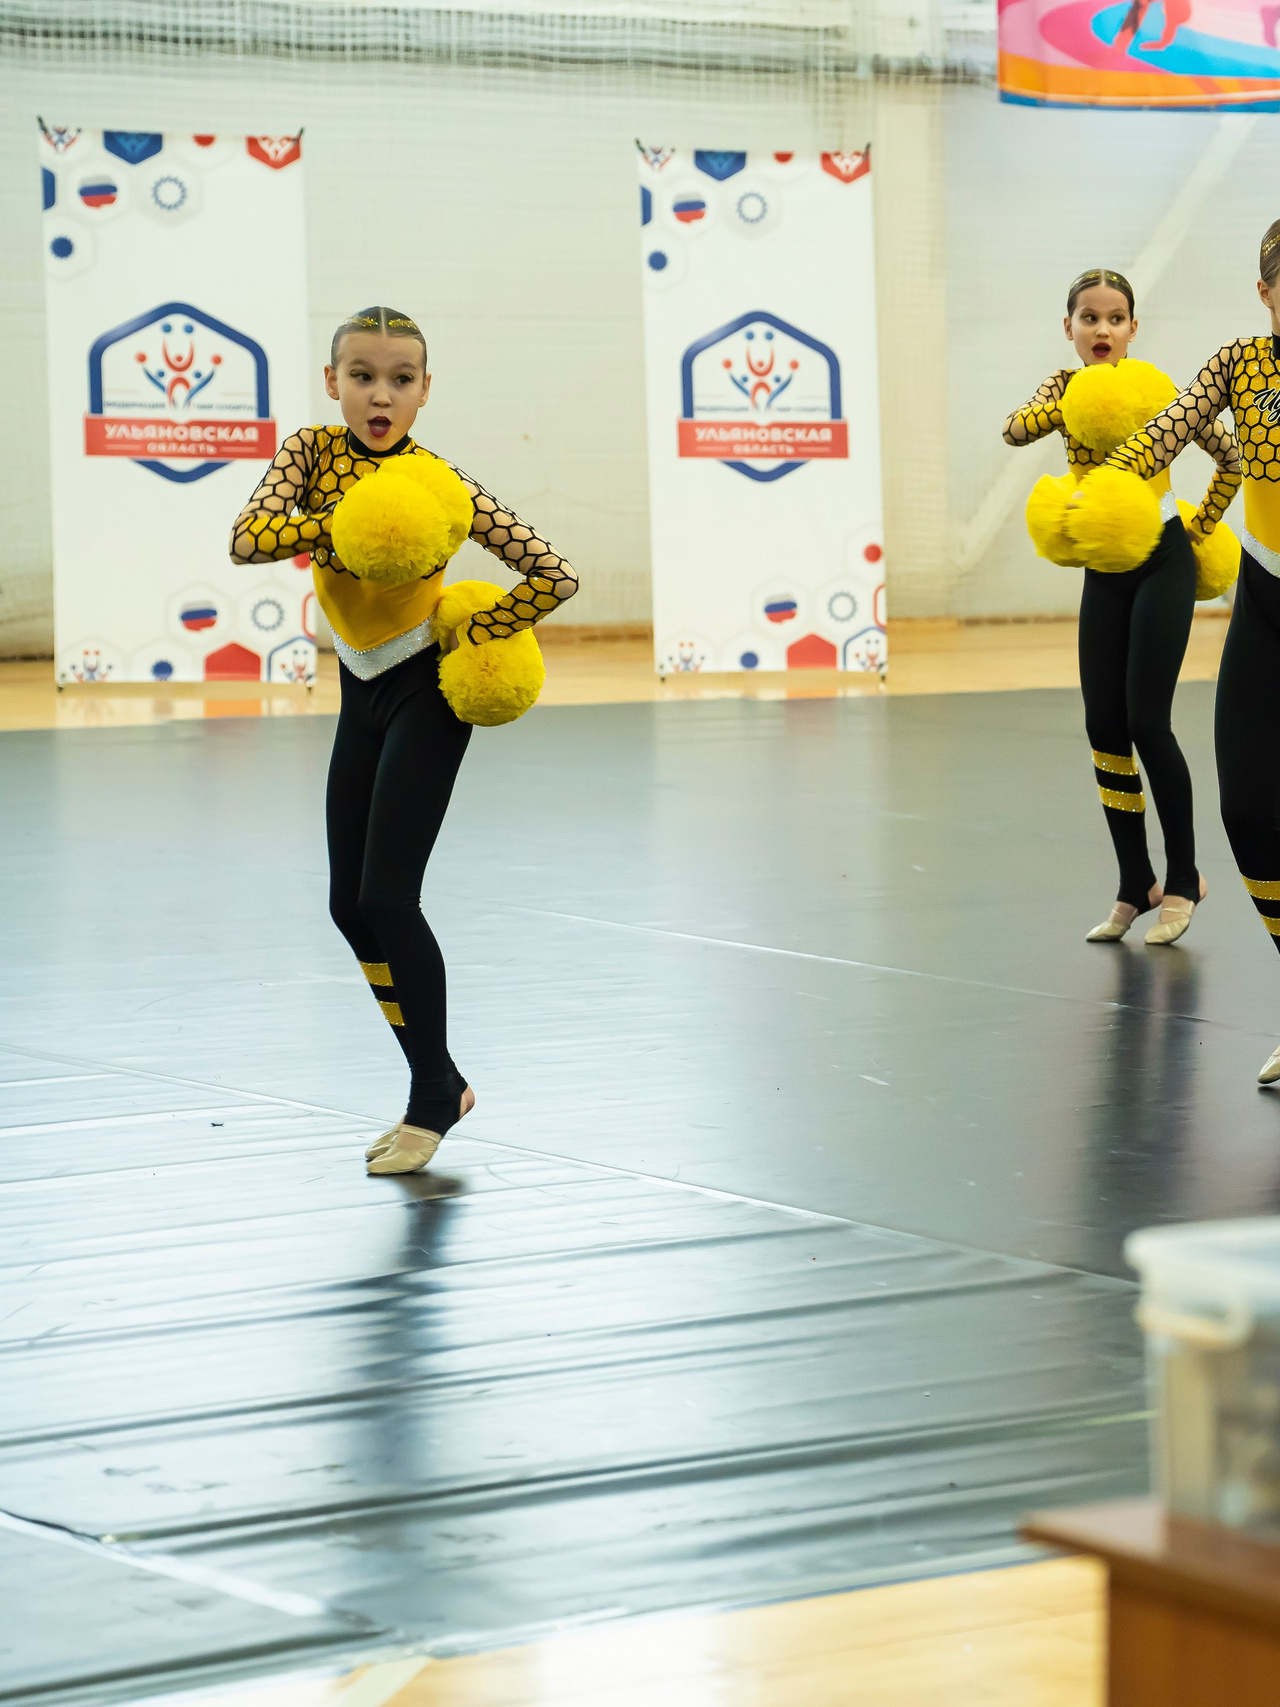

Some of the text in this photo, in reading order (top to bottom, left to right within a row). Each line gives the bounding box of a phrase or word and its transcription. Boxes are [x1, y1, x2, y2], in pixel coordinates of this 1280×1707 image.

[104, 423, 259, 442] УЛЬЯНОВСКАЯ
[694, 427, 832, 443] УЛЬЯНОВСКАЯ
[147, 442, 217, 454] ОБЛАСТЬ
[732, 443, 795, 454] ОБЛАСТЬ
